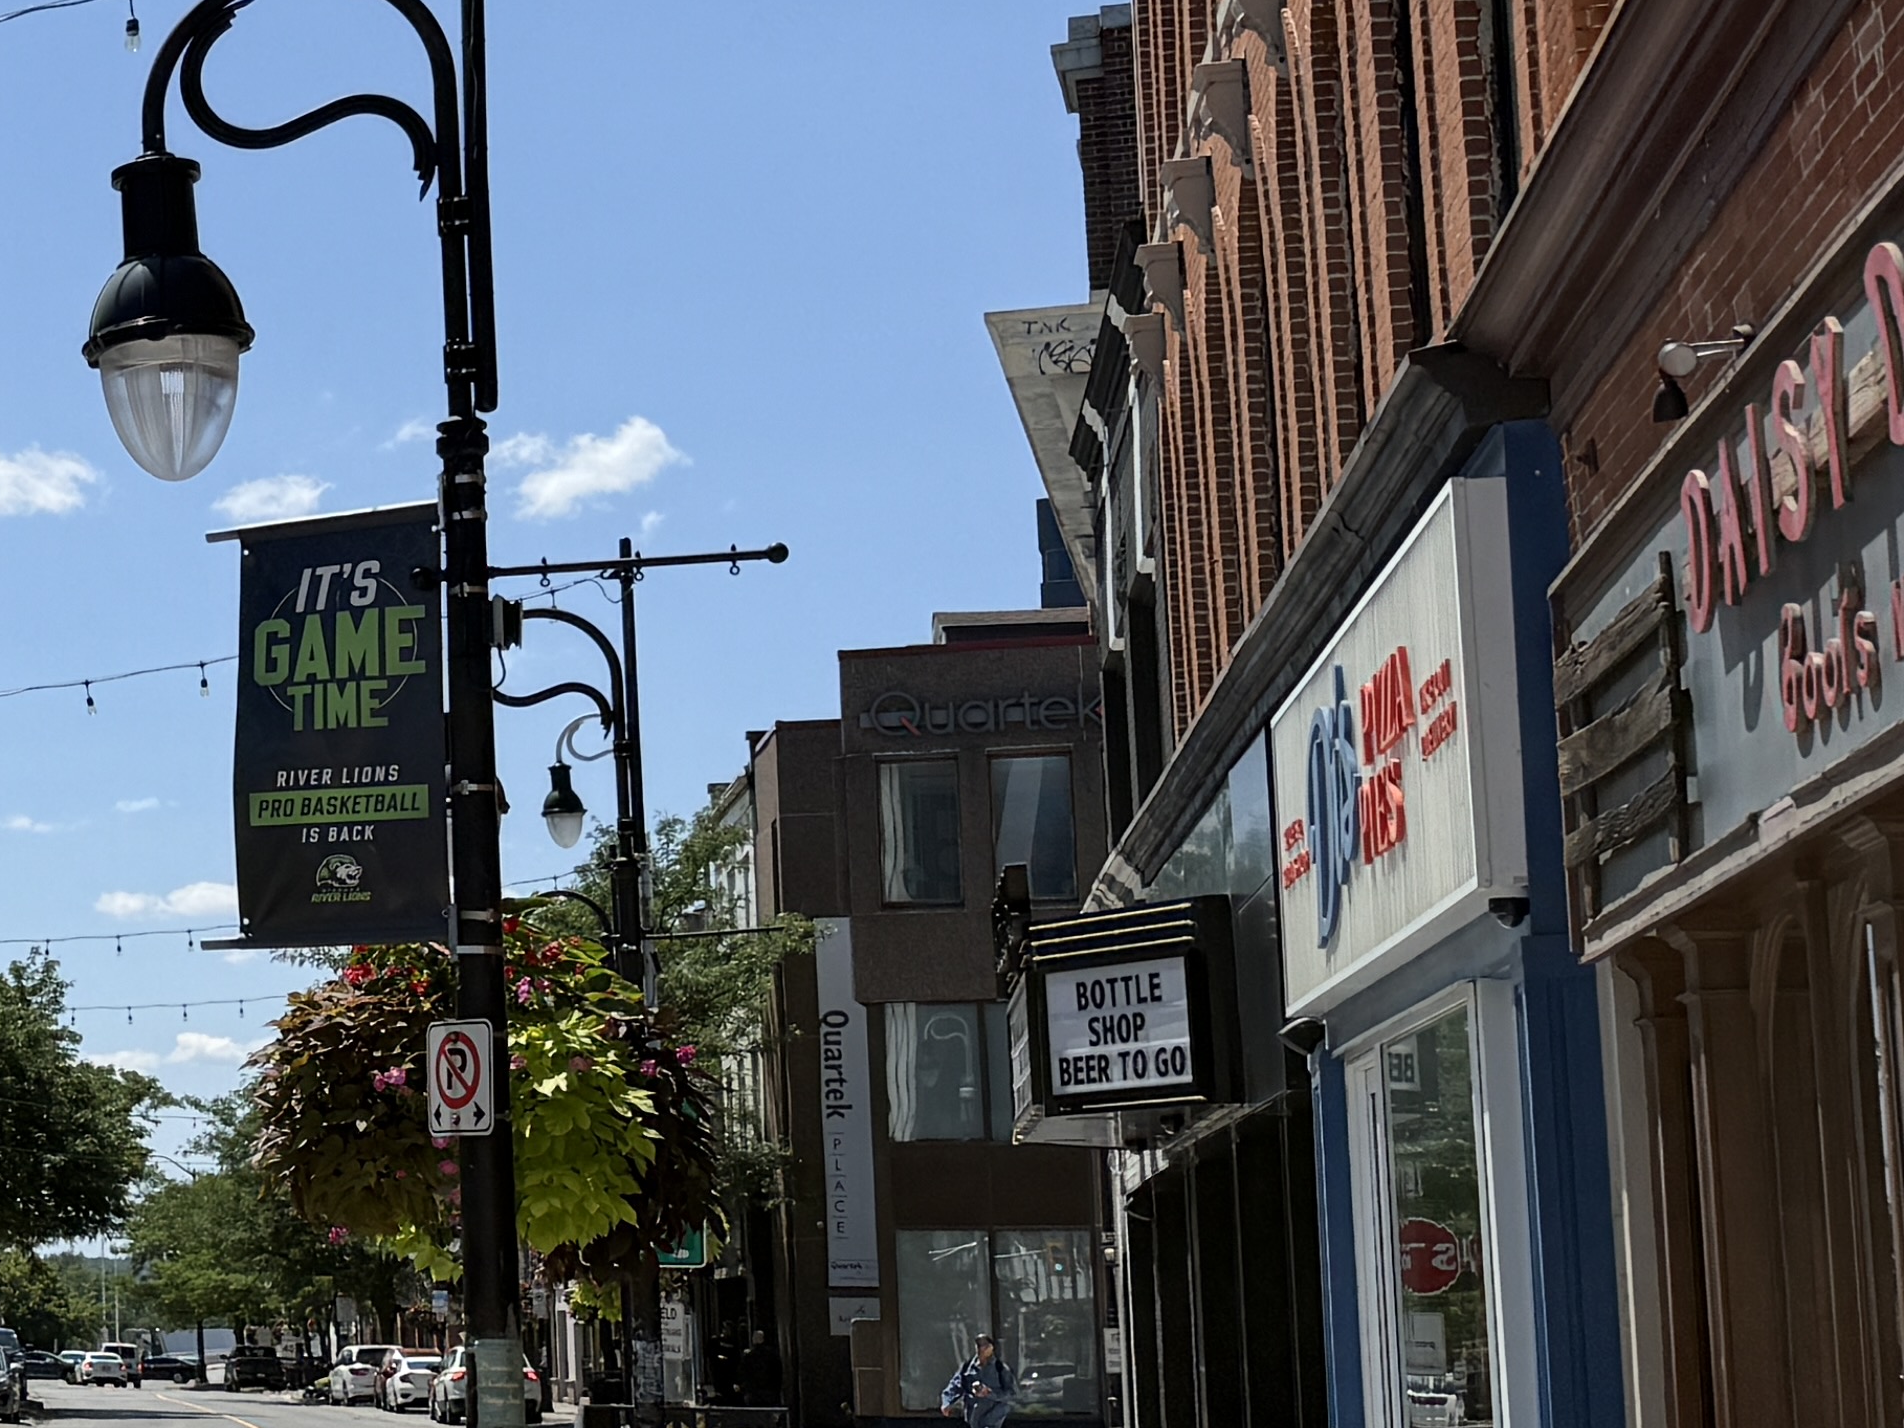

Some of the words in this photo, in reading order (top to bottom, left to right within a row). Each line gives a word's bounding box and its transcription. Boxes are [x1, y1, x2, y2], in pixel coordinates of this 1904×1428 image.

[1681, 316, 1853, 634] DAISY
[294, 559, 381, 613] IT'S
[253, 604, 427, 688] GAME
[286, 679, 389, 732] TIME
[869, 680, 1104, 737] Quartek
[1360, 645, 1416, 767] PIZZA
[276, 768, 333, 788] RIVER
[341, 764, 400, 784] LIONS
[257, 797, 293, 820] PRO
[300, 790, 421, 818] BASKETBALL
[1358, 758, 1408, 866] PIES
[302, 827, 320, 843] IS
[328, 825, 374, 843] BACK
[1076, 972, 1162, 1012] BOTTLE
[1088, 1012, 1146, 1047] SHOP
[821, 1010, 853, 1119] Quartek
[1059, 1054, 1111, 1086] BEER
[1118, 1049, 1147, 1081] TO
[1155, 1046, 1185, 1077] GO
[833, 1138, 846, 1234] PLACE
